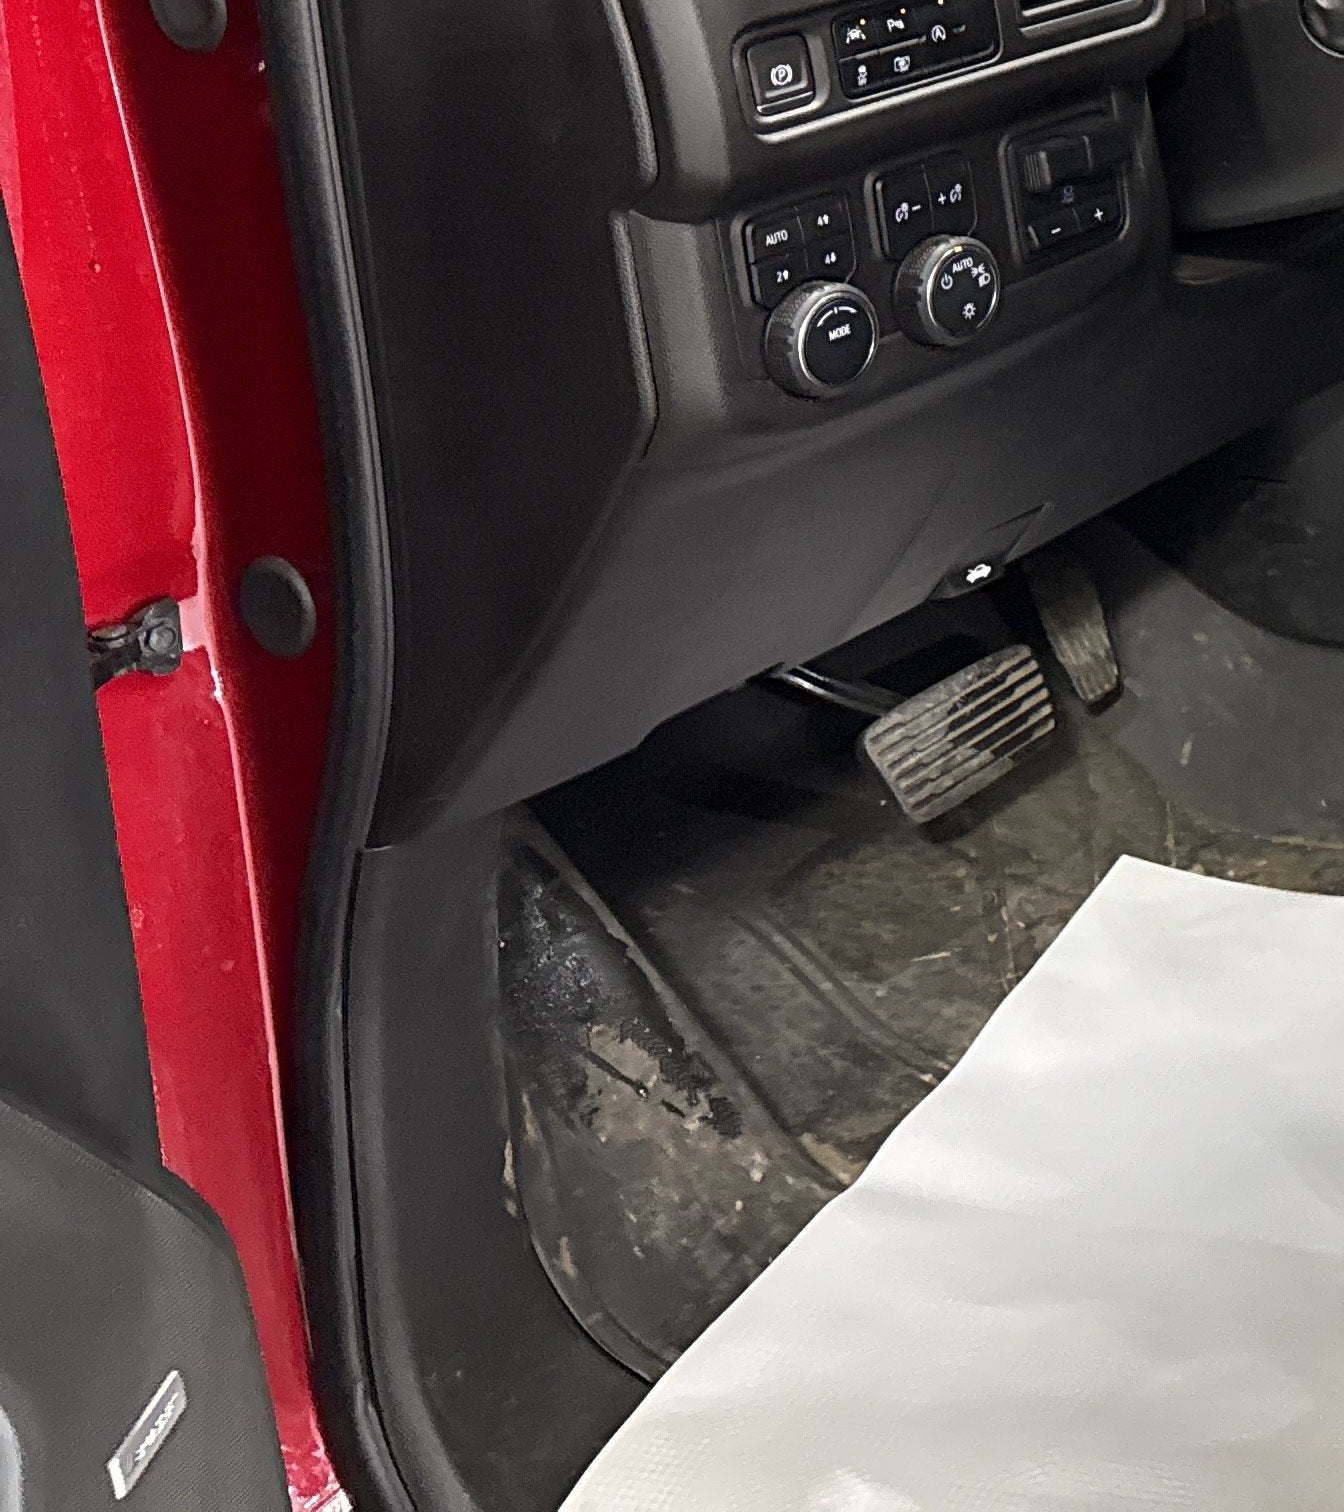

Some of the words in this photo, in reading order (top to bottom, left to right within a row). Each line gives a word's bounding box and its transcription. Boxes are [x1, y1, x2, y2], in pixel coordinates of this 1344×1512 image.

[765, 229, 789, 247] AUTO
[952, 256, 974, 274] AUTO
[828, 323, 852, 342] MODE
